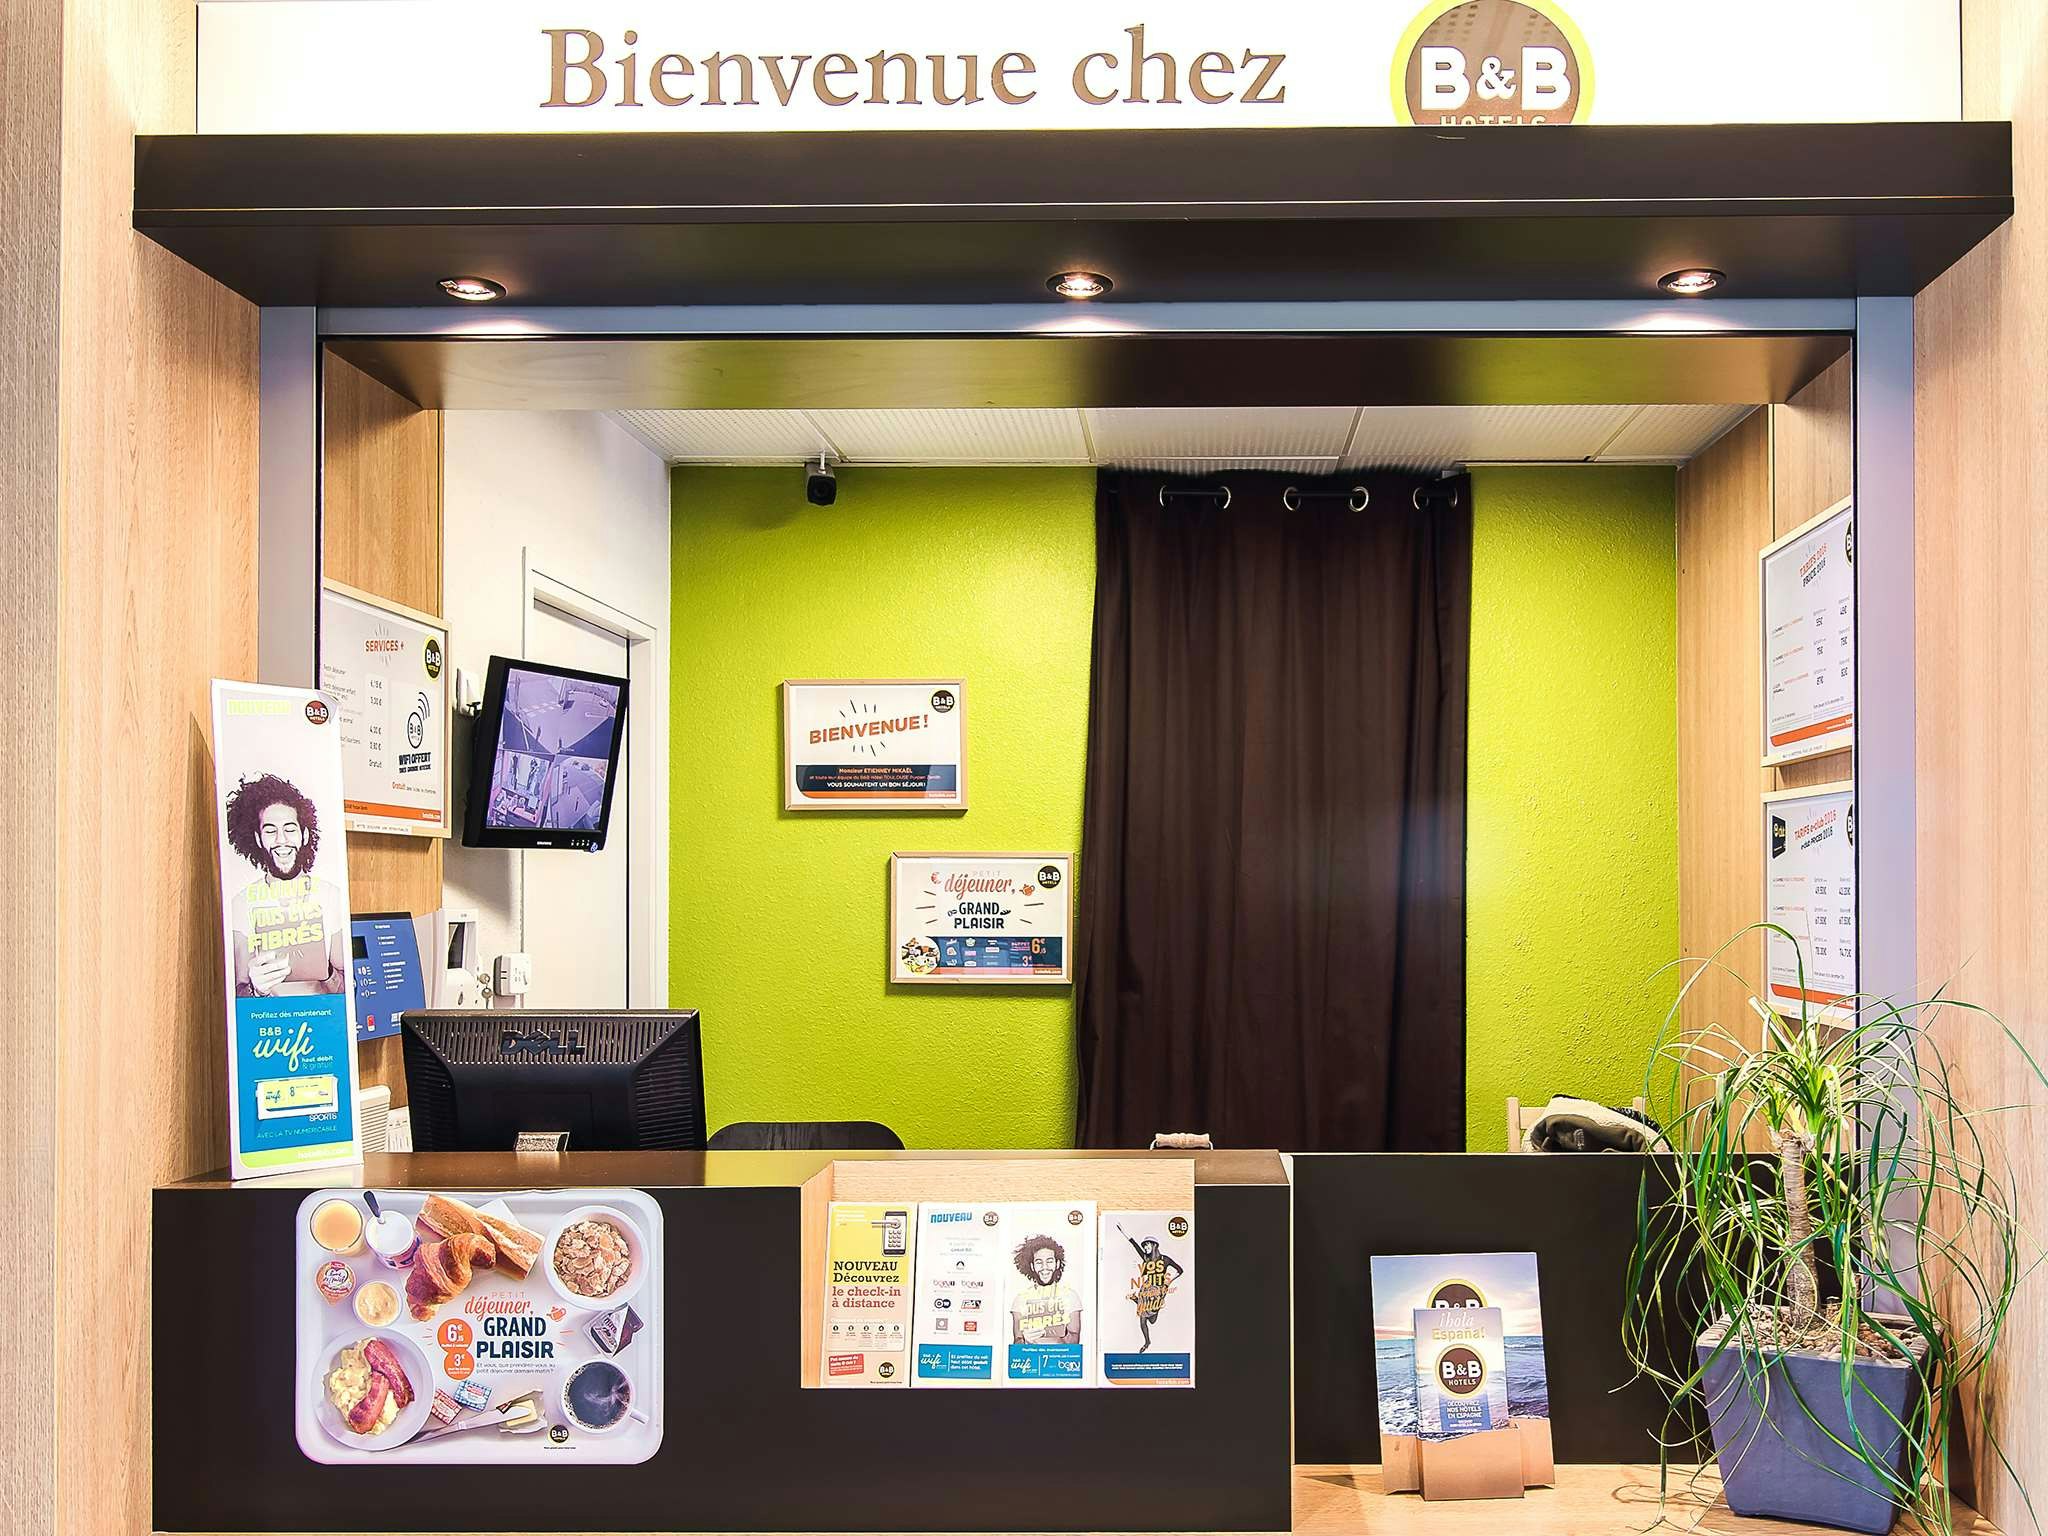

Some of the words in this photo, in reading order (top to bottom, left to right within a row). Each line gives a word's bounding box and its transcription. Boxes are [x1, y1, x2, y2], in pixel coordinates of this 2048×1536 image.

[540, 28, 1038, 108] Bienvenue
[1072, 23, 1287, 106] chez
[1420, 46, 1572, 110] B&B
[365, 640, 398, 652] SERVICES
[426, 649, 440, 667] B&B
[932, 697, 953, 706] B&B
[306, 706, 327, 717] B&B
[809, 715, 921, 744] BIENVENUE
[1039, 872, 1061, 881] B&B
[944, 873, 1016, 900] déjeuner,
[959, 902, 1000, 915] GRAND
[954, 918, 1004, 929] PLAISIR
[248, 922, 325, 953] FIBRÉS
[250, 1011, 278, 1020] Profitez
[279, 1010, 292, 1018] dès
[293, 1008, 332, 1017] maintenant
[260, 1026, 282, 1037] B&B
[252, 1021, 315, 1073] wifi
[501, 1029, 586, 1056] DELL
[309, 1114, 337, 1122] SPORTS
[930, 1211, 973, 1224] NOUVEAU
[1169, 1222, 1188, 1231] B&B
[833, 1261, 898, 1271] NOUVEAU
[832, 1272, 900, 1283] Découvrez
[832, 1286, 844, 1296] le
[847, 1286, 901, 1296] check-in
[832, 1297, 840, 1308] à
[842, 1297, 895, 1308] distance
[484, 1317, 546, 1336] GRAND
[1432, 1327, 1485, 1342] España!
[476, 1341, 554, 1358] PLAISIR
[1442, 1360, 1481, 1379] B&B
[1448, 1378, 1477, 1386] HOTELS
[551, 1430, 568, 1438] B&B
